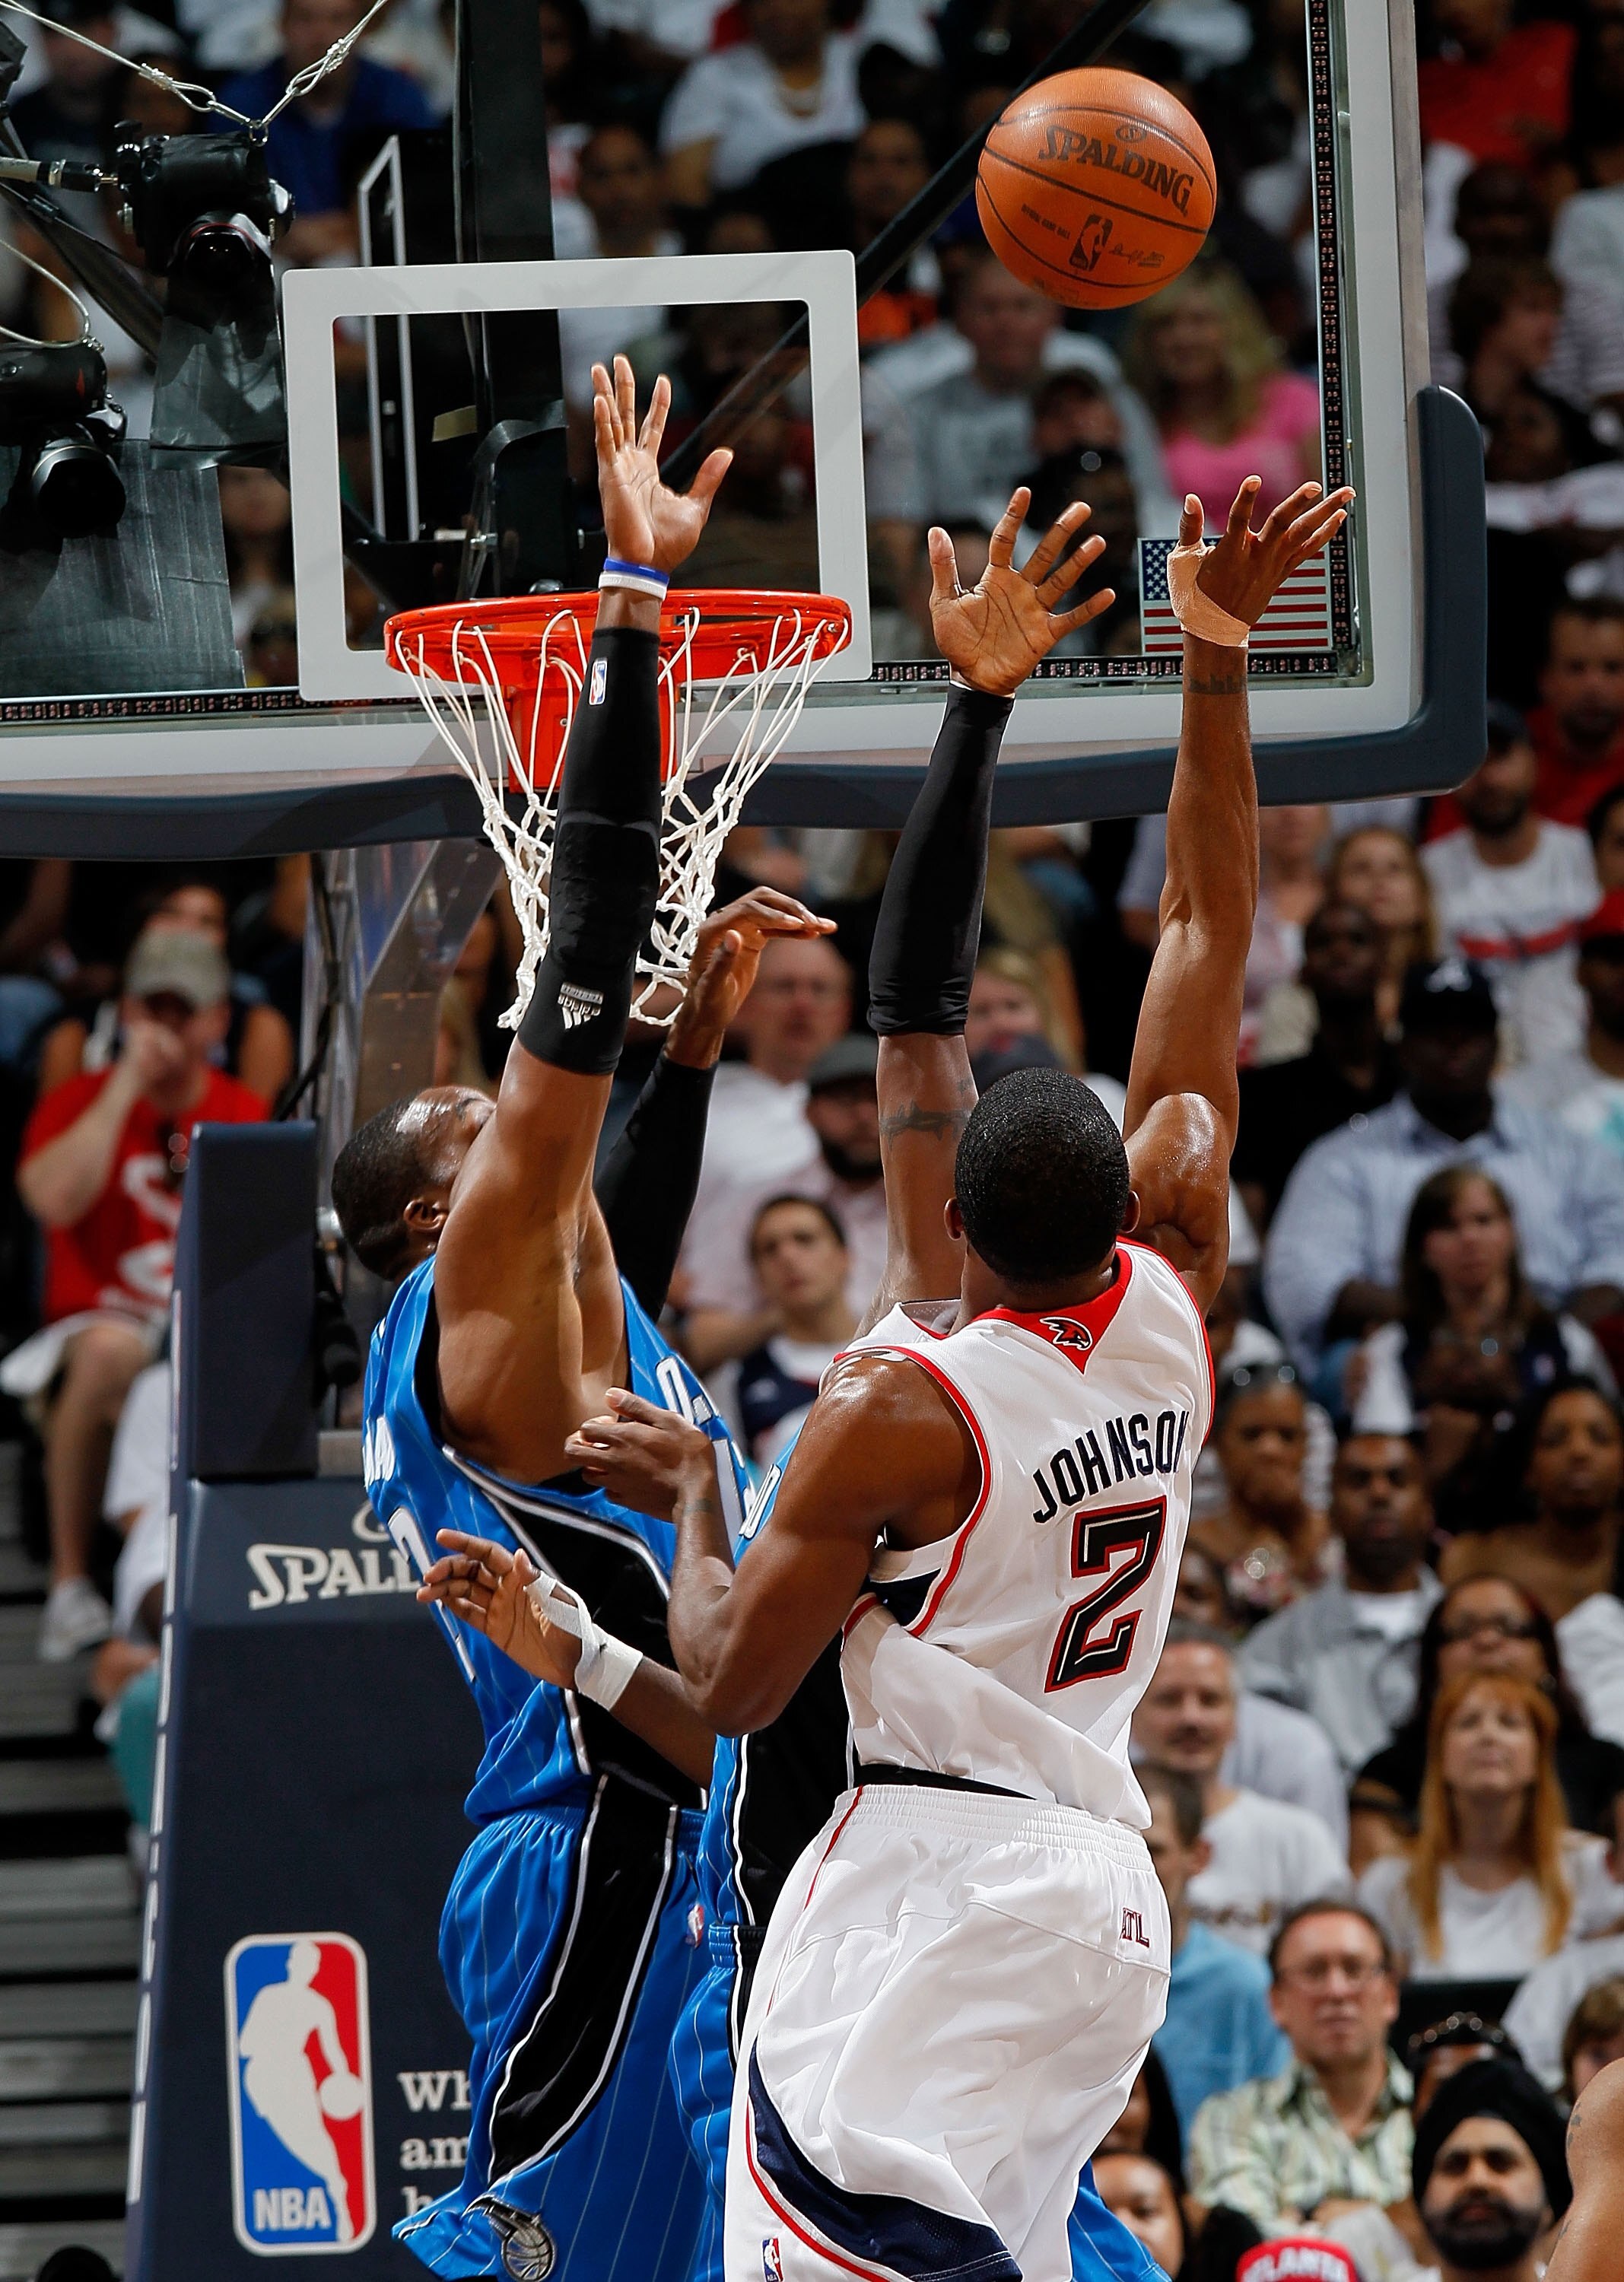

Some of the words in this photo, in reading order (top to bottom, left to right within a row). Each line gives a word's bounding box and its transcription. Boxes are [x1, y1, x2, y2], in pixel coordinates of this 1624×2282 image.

[1038, 124, 1194, 218] SPALDING
[1044, 1495, 1168, 1694] 2
[253, 2185, 332, 2233] NBA
